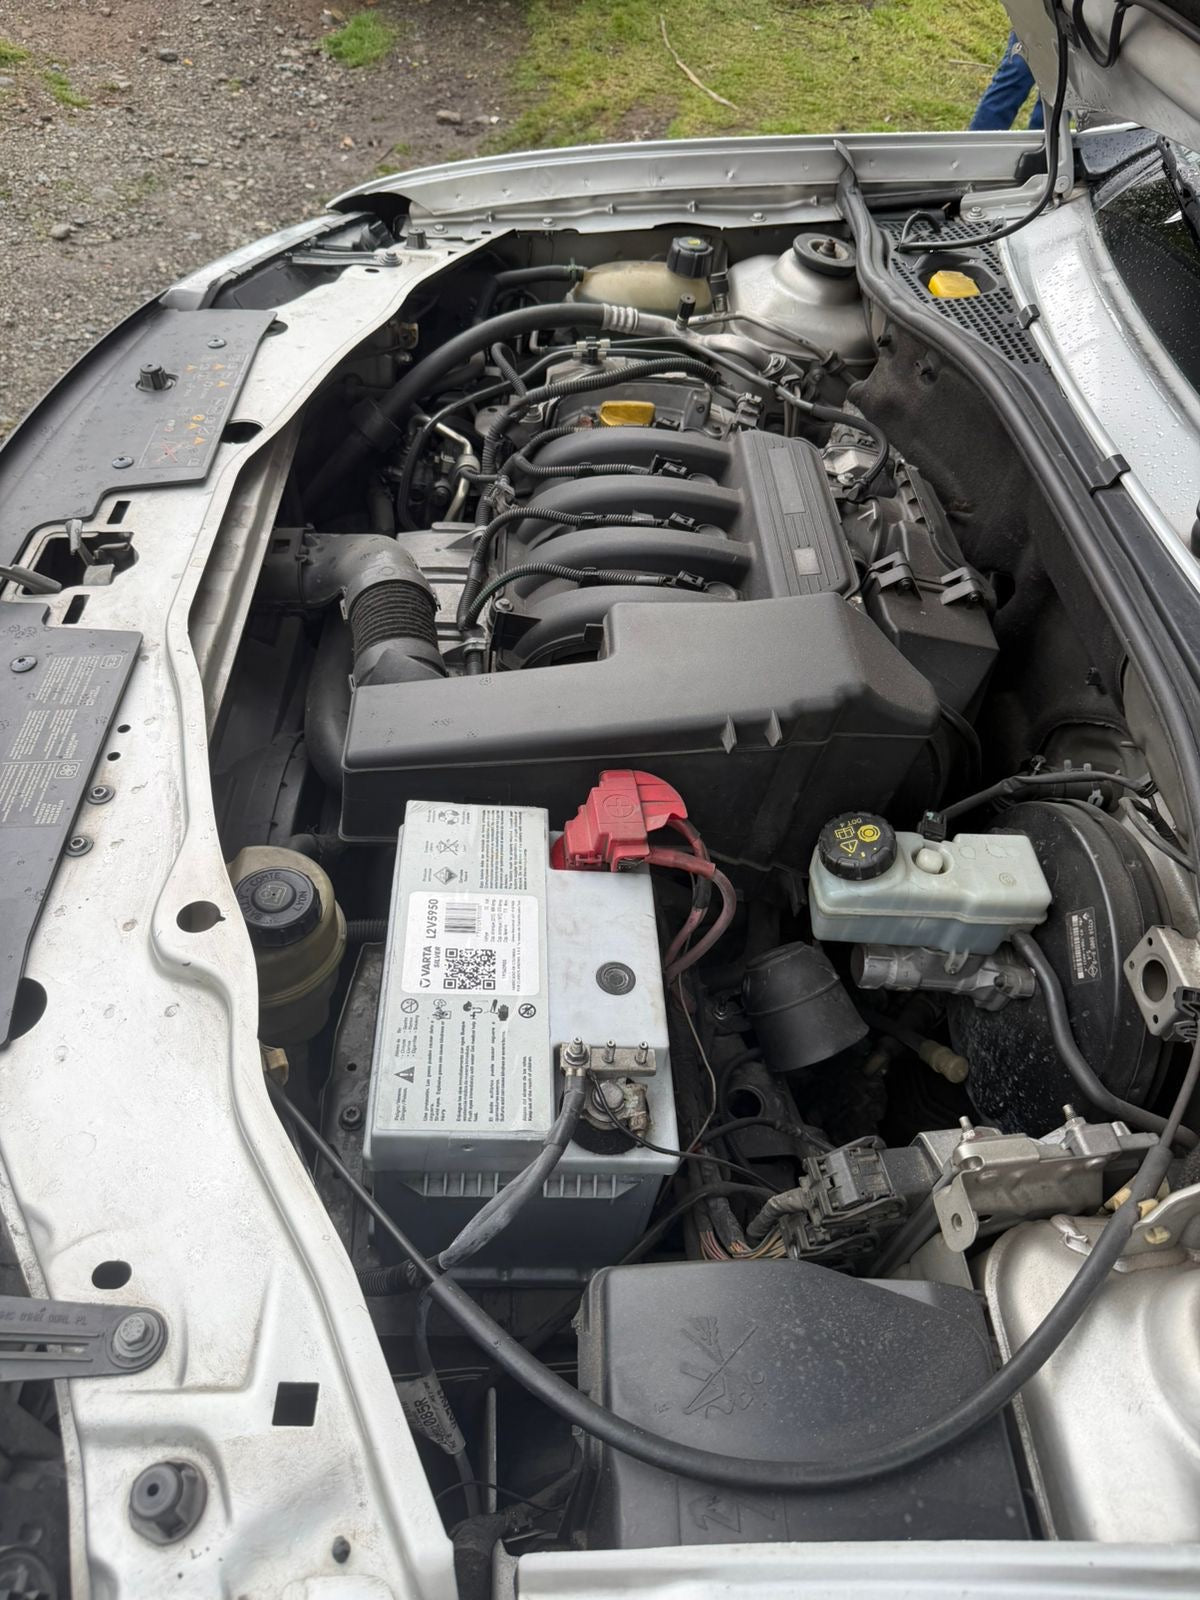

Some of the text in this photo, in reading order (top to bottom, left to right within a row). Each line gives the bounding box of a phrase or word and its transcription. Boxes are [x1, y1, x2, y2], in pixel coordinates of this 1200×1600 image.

[294, 890, 308, 912] LYON
[426, 899, 438, 939] L2V5950
[421, 946, 432, 976] VARTA
